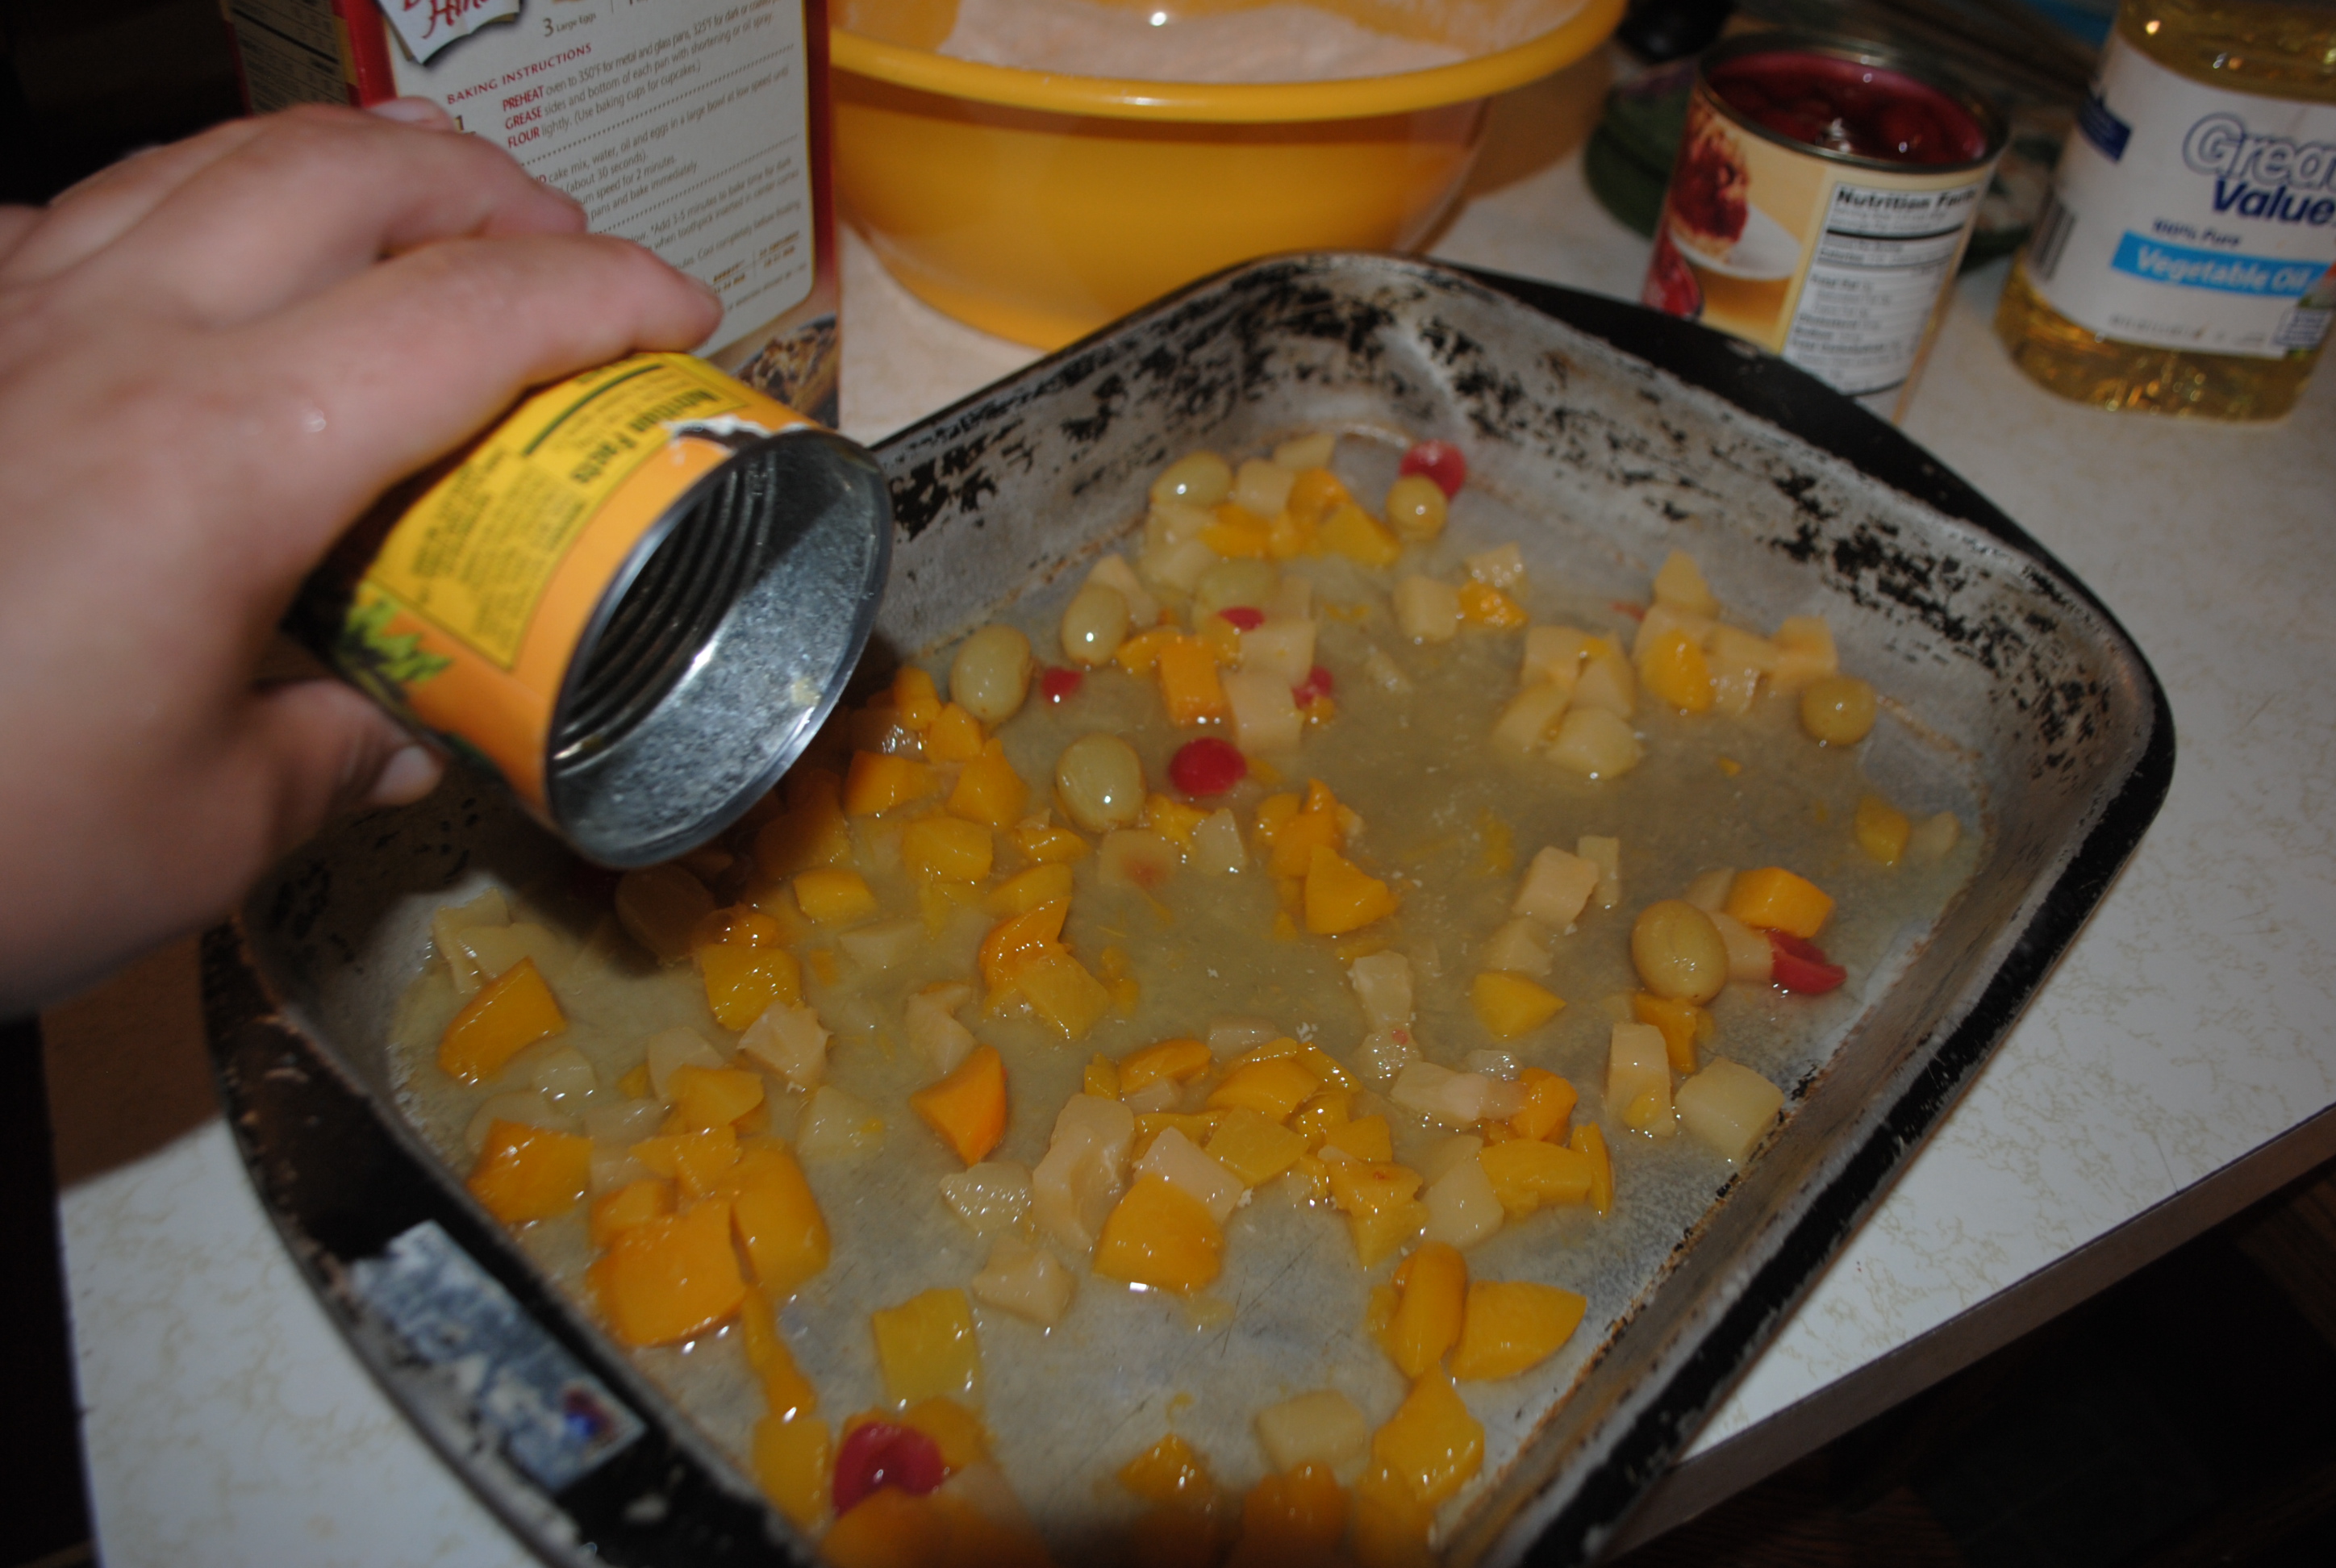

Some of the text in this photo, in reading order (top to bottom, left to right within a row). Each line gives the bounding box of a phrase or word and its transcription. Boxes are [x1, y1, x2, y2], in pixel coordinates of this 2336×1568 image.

[543, 11, 597, 37] 3 Large Eggs
[447, 42, 593, 105] BAKING INSTRUCTIONS
[503, 85, 544, 111] PREHEAT
[546, 80, 566, 96] oven
[568, 73, 578, 86] to
[603, 60, 613, 73] for
[615, 48, 637, 68] metal
[639, 44, 653, 59] and
[654, 37, 672, 55] glass
[505, 105, 543, 130] GREASE
[544, 101, 566, 116] sides
[568, 91, 586, 106] and
[588, 75, 620, 99] bottom
[622, 70, 631, 84] of
[633, 62, 653, 79] each
[654, 56, 670, 74] pan
[672, 48, 690, 63] with
[691, 30, 732, 54] shortening
[507, 126, 540, 149] FLOUR
[542, 116, 573, 139] lightly.
[574, 106, 594, 126] (Use
[596, 91, 625, 115] baking
[627, 84, 646, 102] cups
[648, 78, 659, 92] for
[549, 167, 569, 183] cake
[620, 139, 630, 152] oil
[632, 131, 649, 146] and
[650, 123, 670, 140] eggs
[566, 174, 595, 195] (about
[598, 165, 609, 179] 30
[590, 203, 611, 223] pans
[613, 194, 629, 210] and
[630, 184, 649, 202] bake
[596, 180, 621, 202] speed
[623, 173, 634, 188] for
[1837, 186, 1933, 209] Nutrition
[2138, 243, 2312, 292] Vegetable Oil
